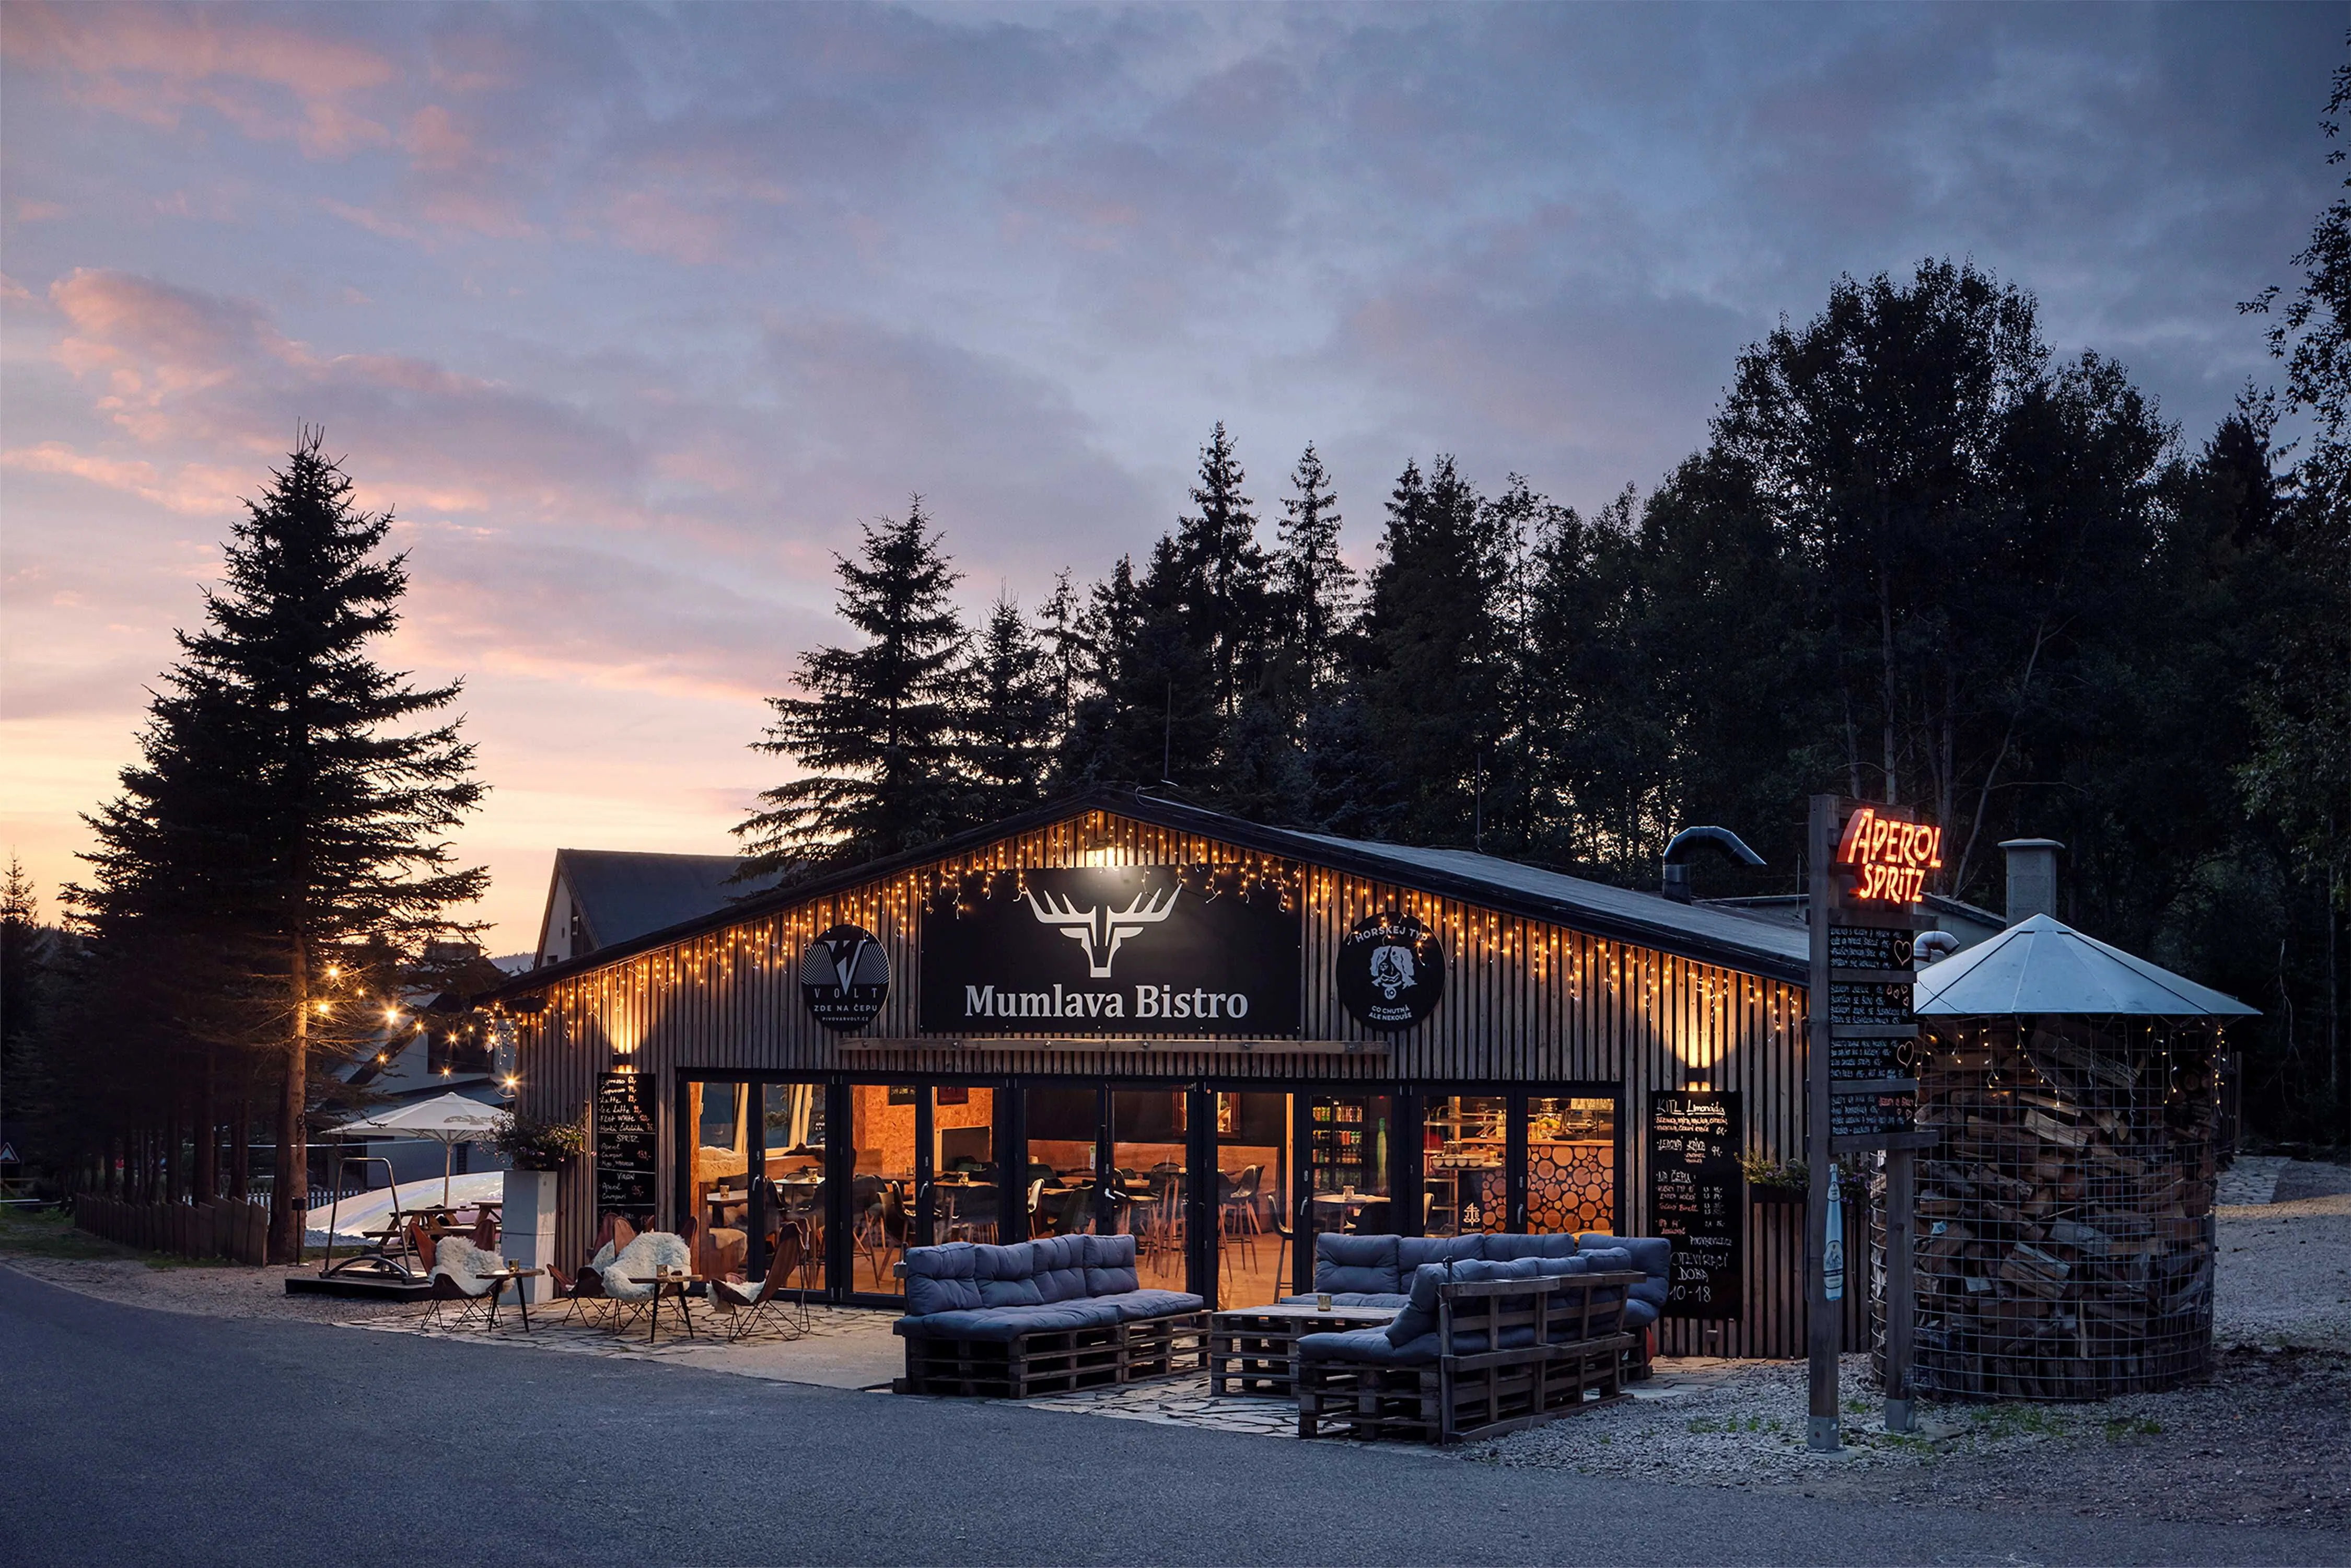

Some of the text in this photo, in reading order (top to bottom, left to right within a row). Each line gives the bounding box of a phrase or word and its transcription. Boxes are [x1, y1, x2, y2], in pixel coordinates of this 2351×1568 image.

[1847, 808, 1941, 868] APEROL
[1355, 926, 1406, 943] HORSKEJ
[814, 988, 878, 998] VOLT
[964, 983, 1248, 1019] Mumlava Bistro
[854, 1003, 878, 1012] ČEPU
[1382, 1004, 1410, 1014] CHUTNÁ
[1382, 1012, 1412, 1021] NEKOUŠE
[600, 1095, 621, 1104] Latte
[613, 1105, 630, 1113] Latte
[1670, 1249, 1728, 1270] OTEVÍRACÍ
[1678, 1267, 1709, 1283] DOBA
